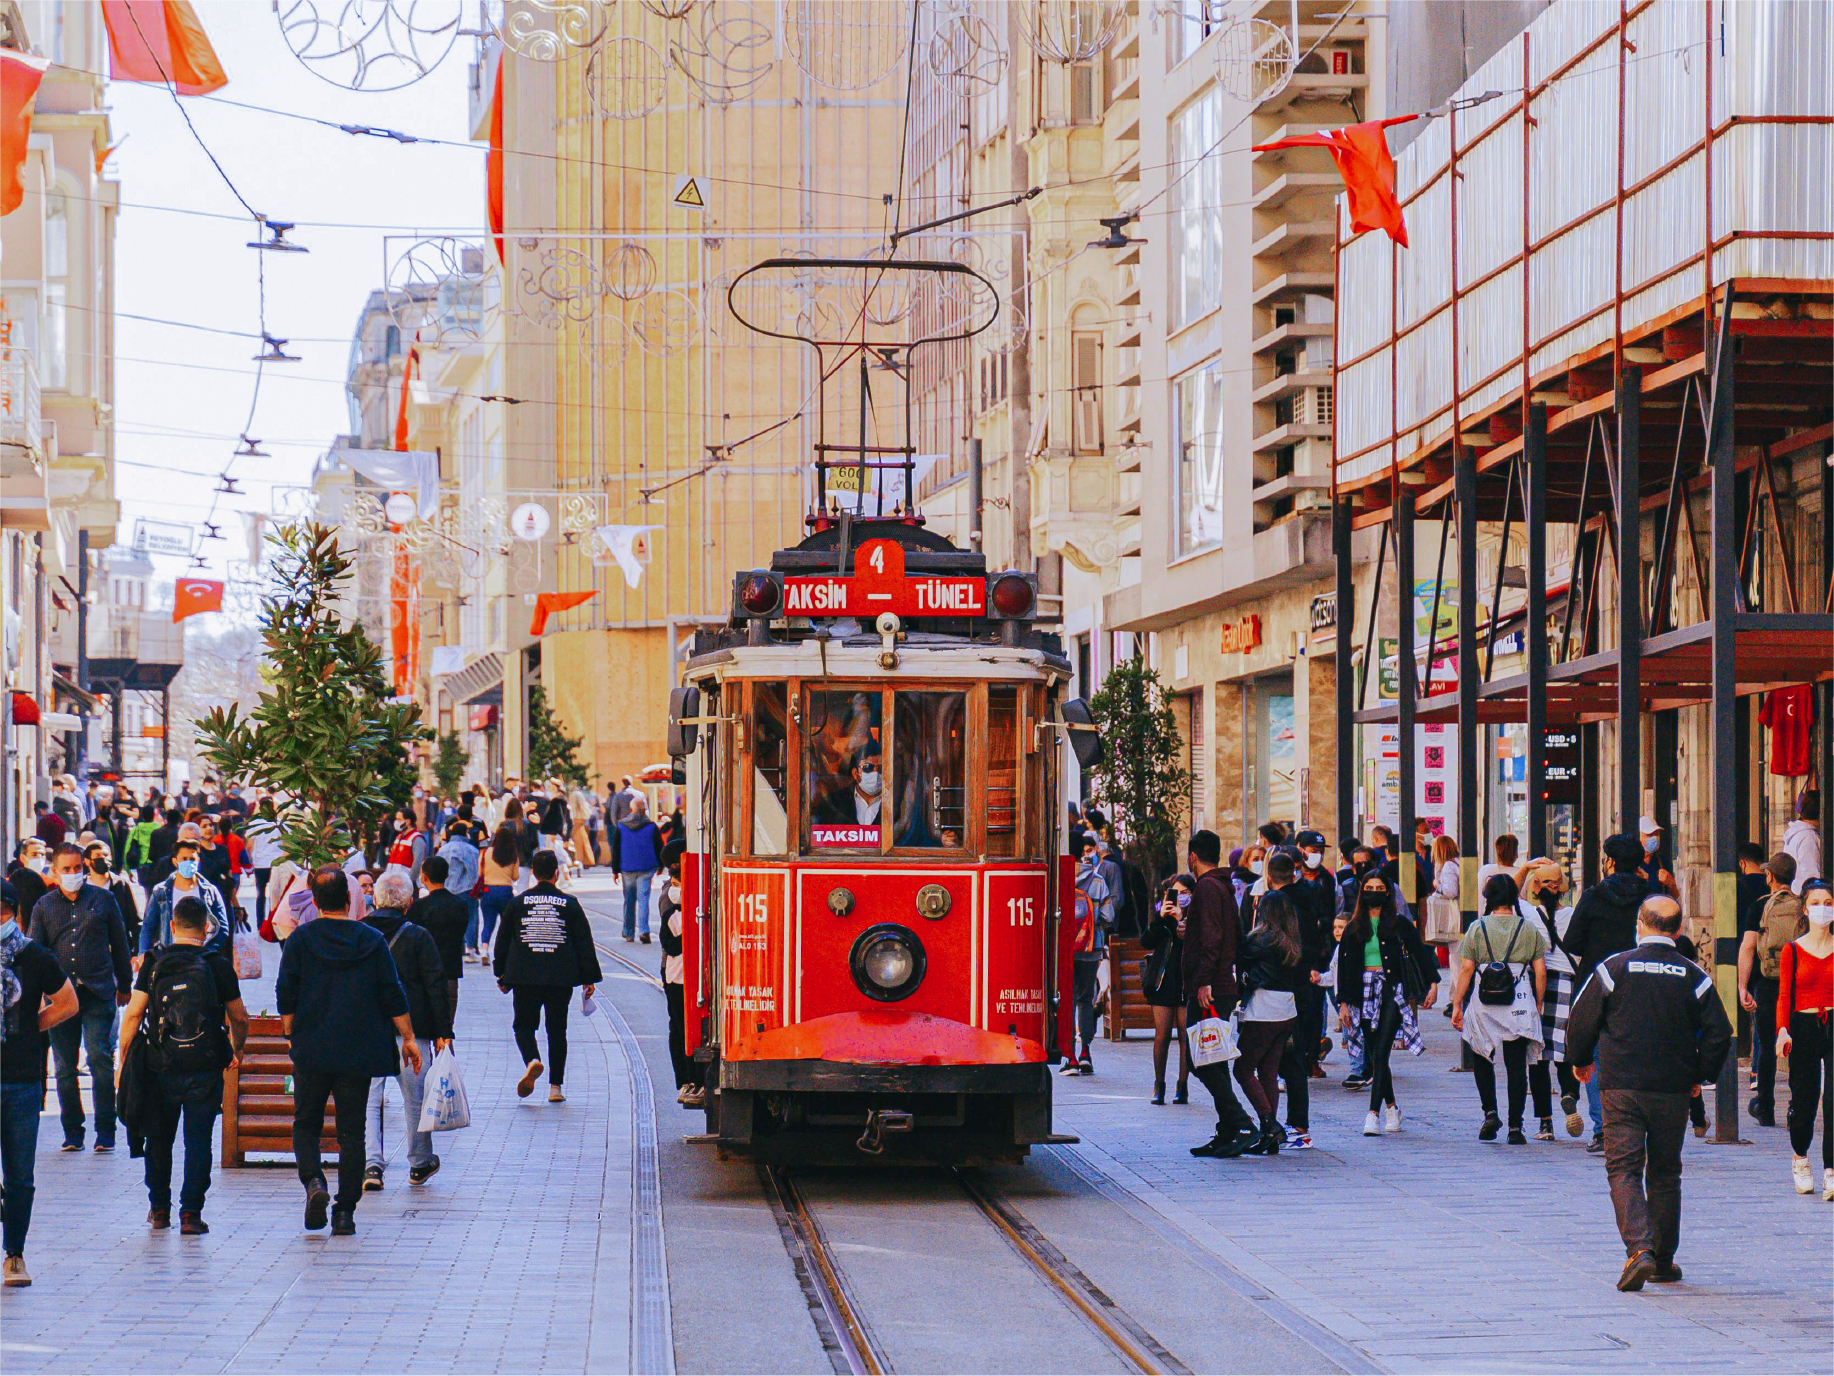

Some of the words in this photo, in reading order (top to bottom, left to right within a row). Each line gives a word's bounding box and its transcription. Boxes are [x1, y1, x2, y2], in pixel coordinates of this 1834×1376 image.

[869, 545, 884, 574] 4
[915, 579, 981, 610] TÜNEL
[1548, 734, 1566, 743] USD
[1548, 767, 1566, 776] EUR
[812, 828, 879, 842] TAKSİM
[524, 895, 567, 906] DSQUARED2
[737, 893, 768, 923] 115
[1007, 897, 1034, 926] 115
[1628, 961, 1687, 977] BEKO
[748, 986, 773, 998] YASAK
[999, 988, 1029, 1000] ASILMAK
[995, 1002, 1007, 1014] VE
